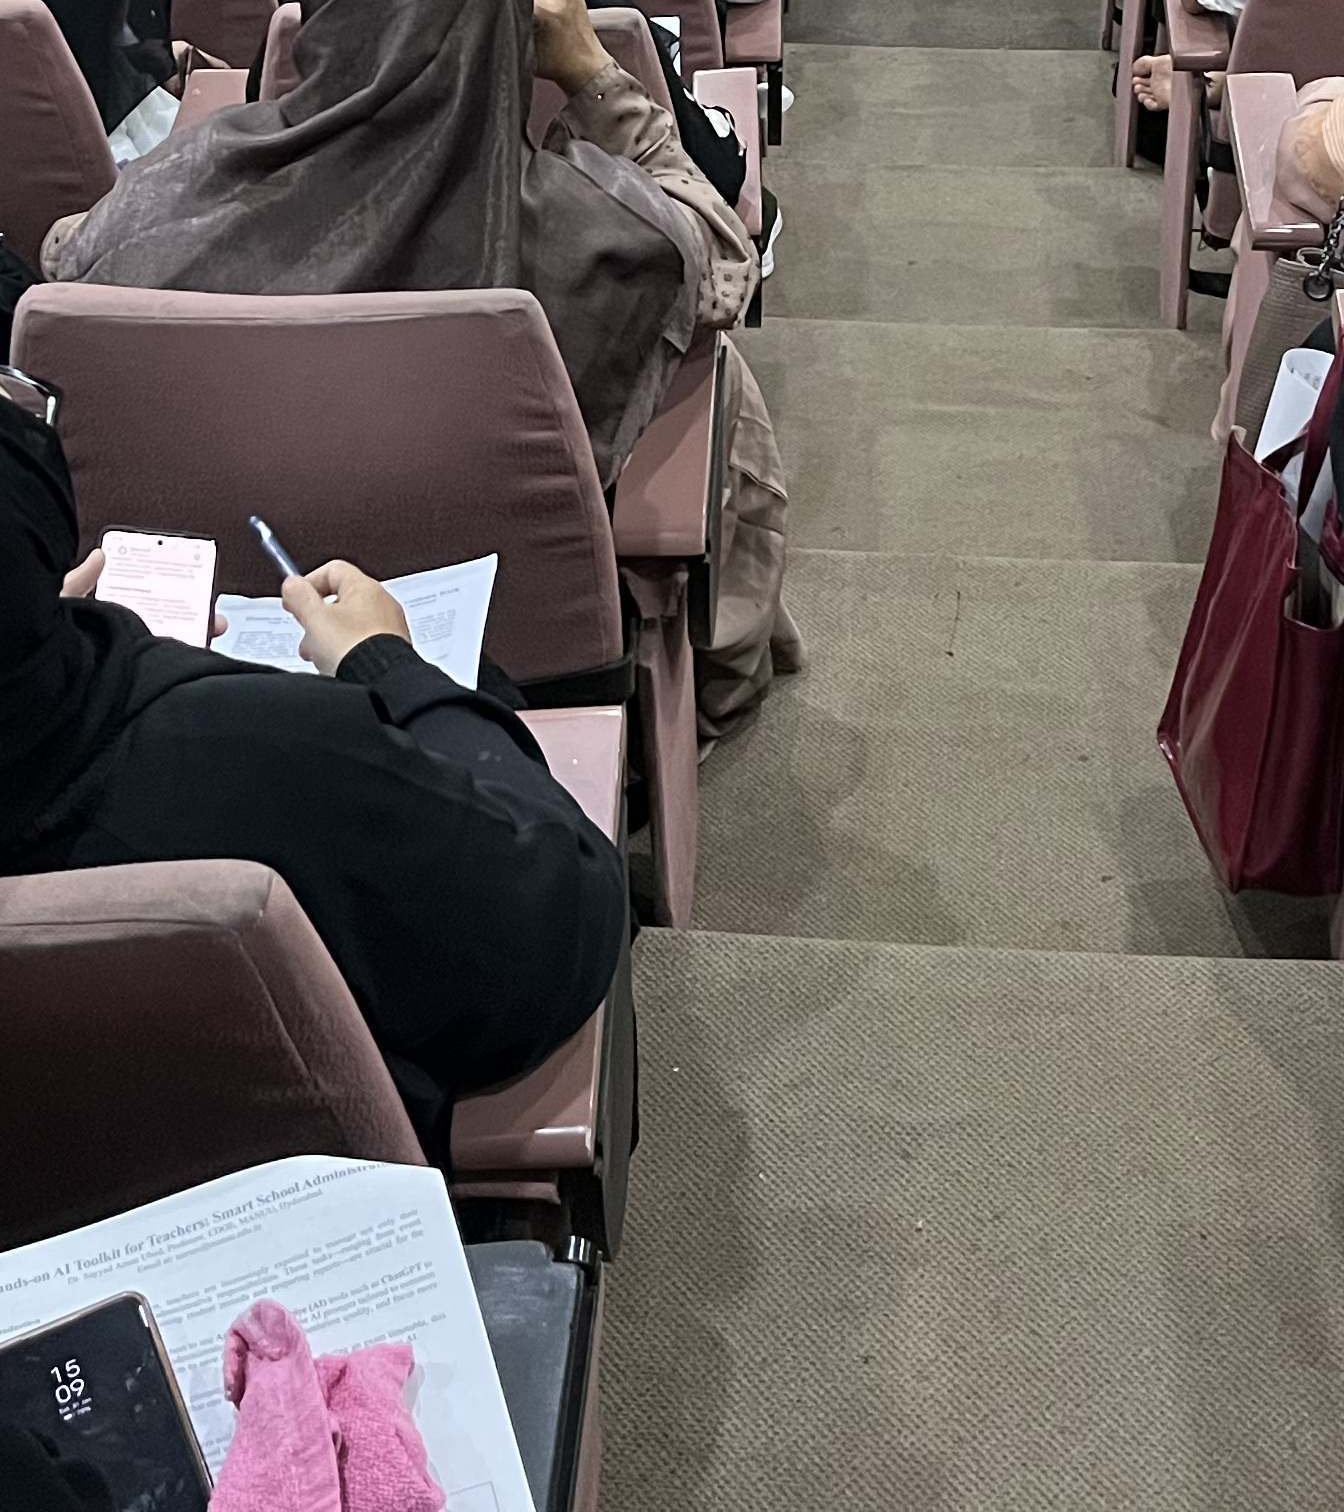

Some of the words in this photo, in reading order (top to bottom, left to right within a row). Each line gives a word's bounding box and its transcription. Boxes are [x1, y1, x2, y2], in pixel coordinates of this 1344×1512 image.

[52, 1263, 71, 1279] AI
[73, 1248, 122, 1272] Toolkit
[124, 1240, 145, 1257] for
[145, 1217, 210, 1248] Teachers:
[211, 1199, 255, 1224] Smart
[255, 1180, 300, 1209] School
[50, 1358, 81, 1383] 15
[55, 1378, 85, 1404] 09
